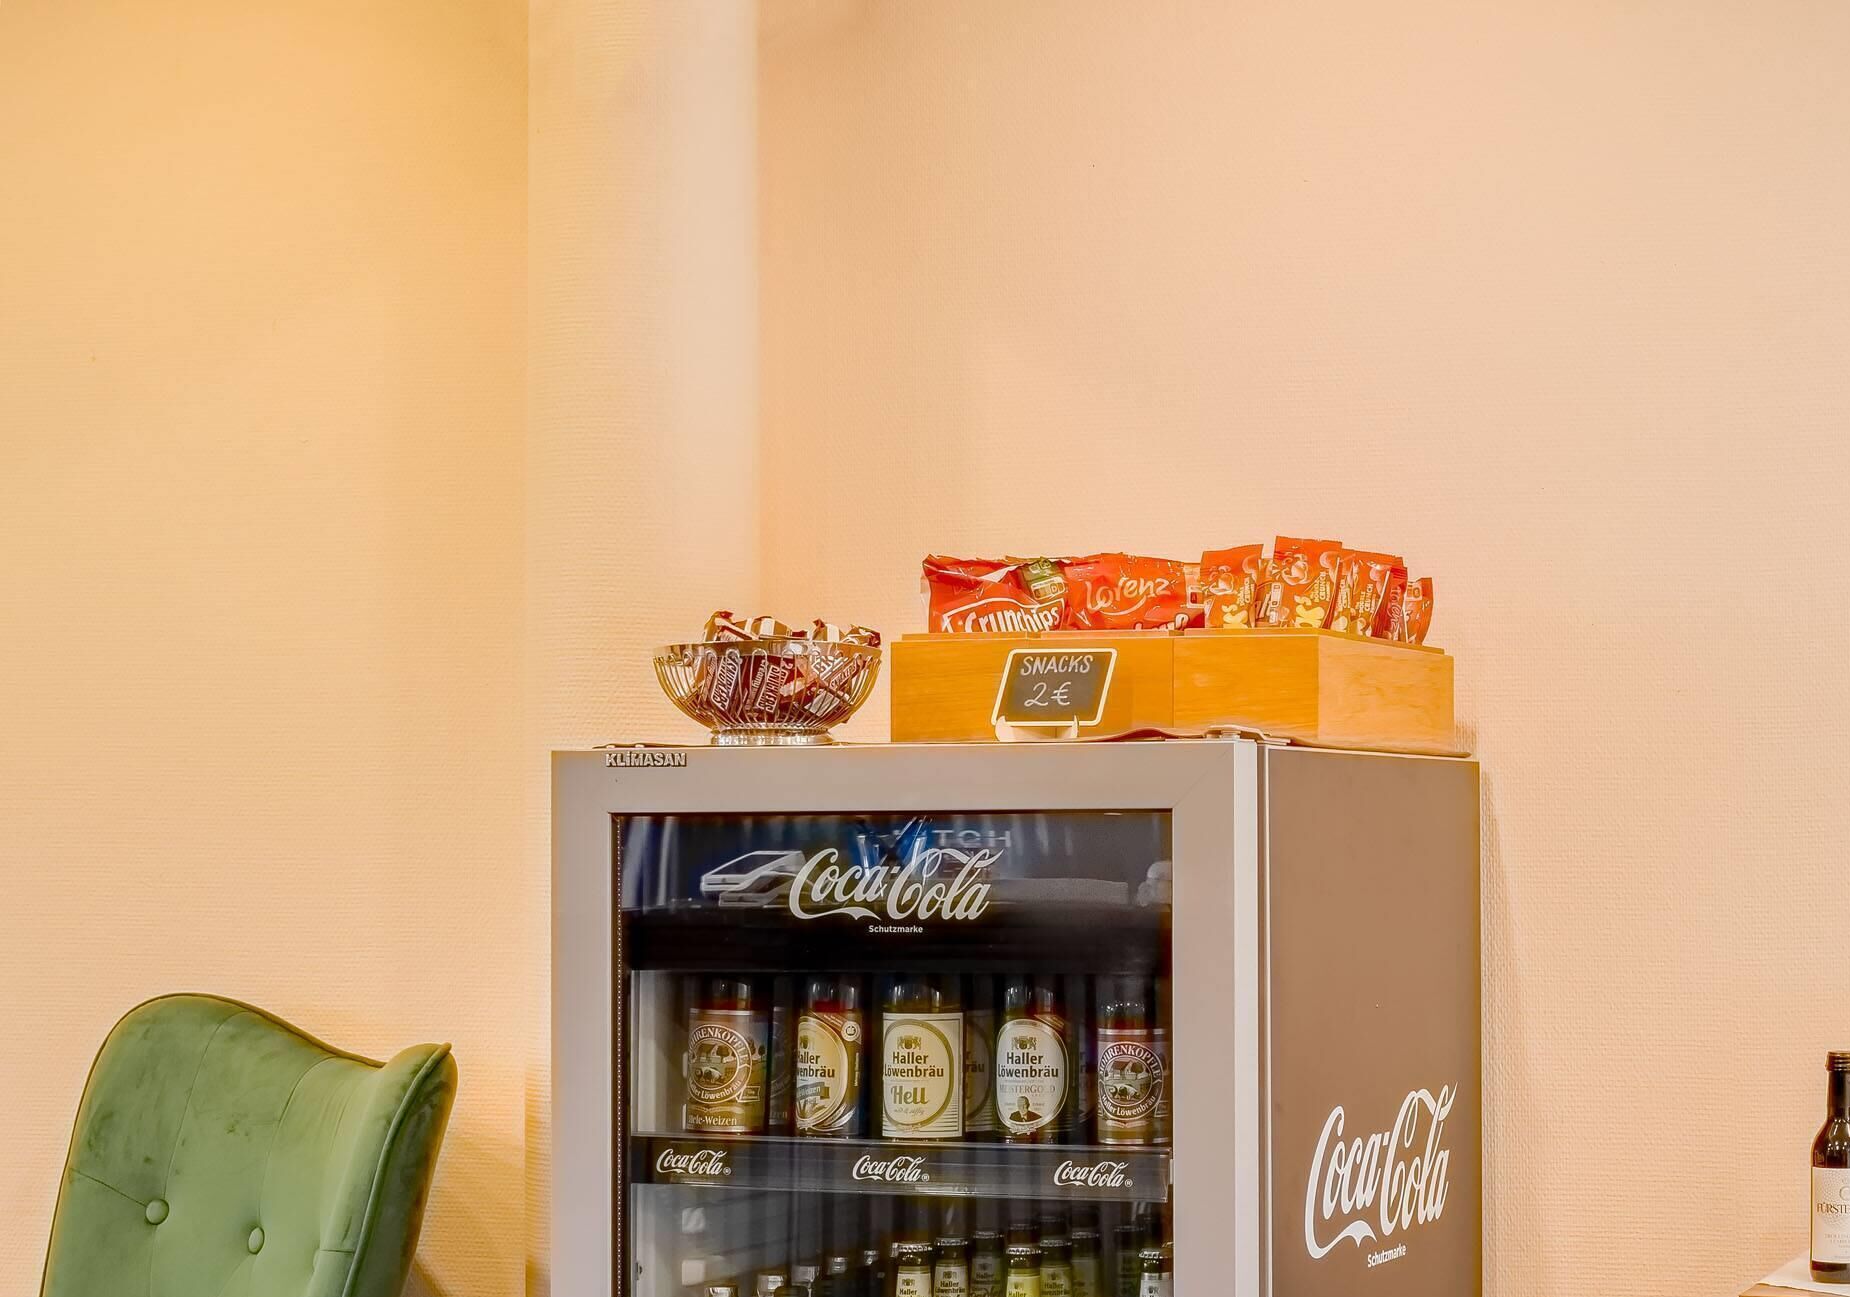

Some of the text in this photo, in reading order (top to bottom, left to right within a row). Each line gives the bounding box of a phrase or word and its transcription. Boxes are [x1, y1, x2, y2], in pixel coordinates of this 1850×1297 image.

[1084, 575, 1171, 614] Lorenz
[1020, 654, 1094, 677] SNACKS
[789, 847, 1005, 921] Coca-Cola
[868, 923, 924, 934] Schutzmarke
[892, 1051, 929, 1065] Haller
[1006, 1051, 1044, 1065] Haller
[884, 1064, 944, 1078] Löwenbräu
[998, 1064, 1059, 1079] Löwenbräu
[890, 1085, 929, 1105] Hell
[1304, 1081, 1458, 1259] Coca-Cola
[1367, 1243, 1407, 1268] Schutzmarke
